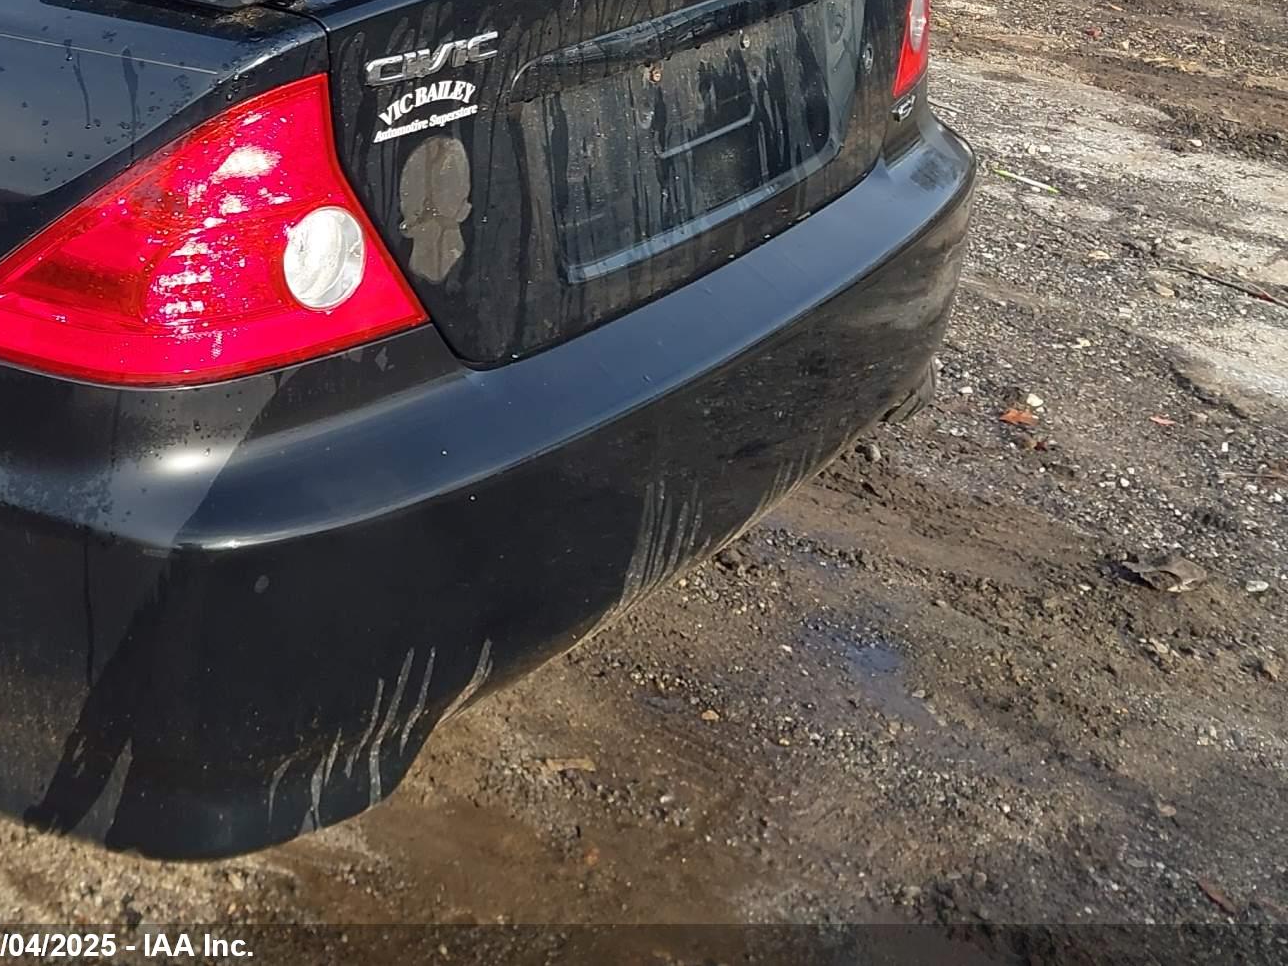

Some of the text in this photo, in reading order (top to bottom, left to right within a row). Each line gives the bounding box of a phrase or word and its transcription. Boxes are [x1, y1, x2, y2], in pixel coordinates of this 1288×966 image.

[365, 31, 499, 87] CIVIC
[378, 80, 476, 125] VIC BAILEY
[373, 119, 429, 143] Automotive
